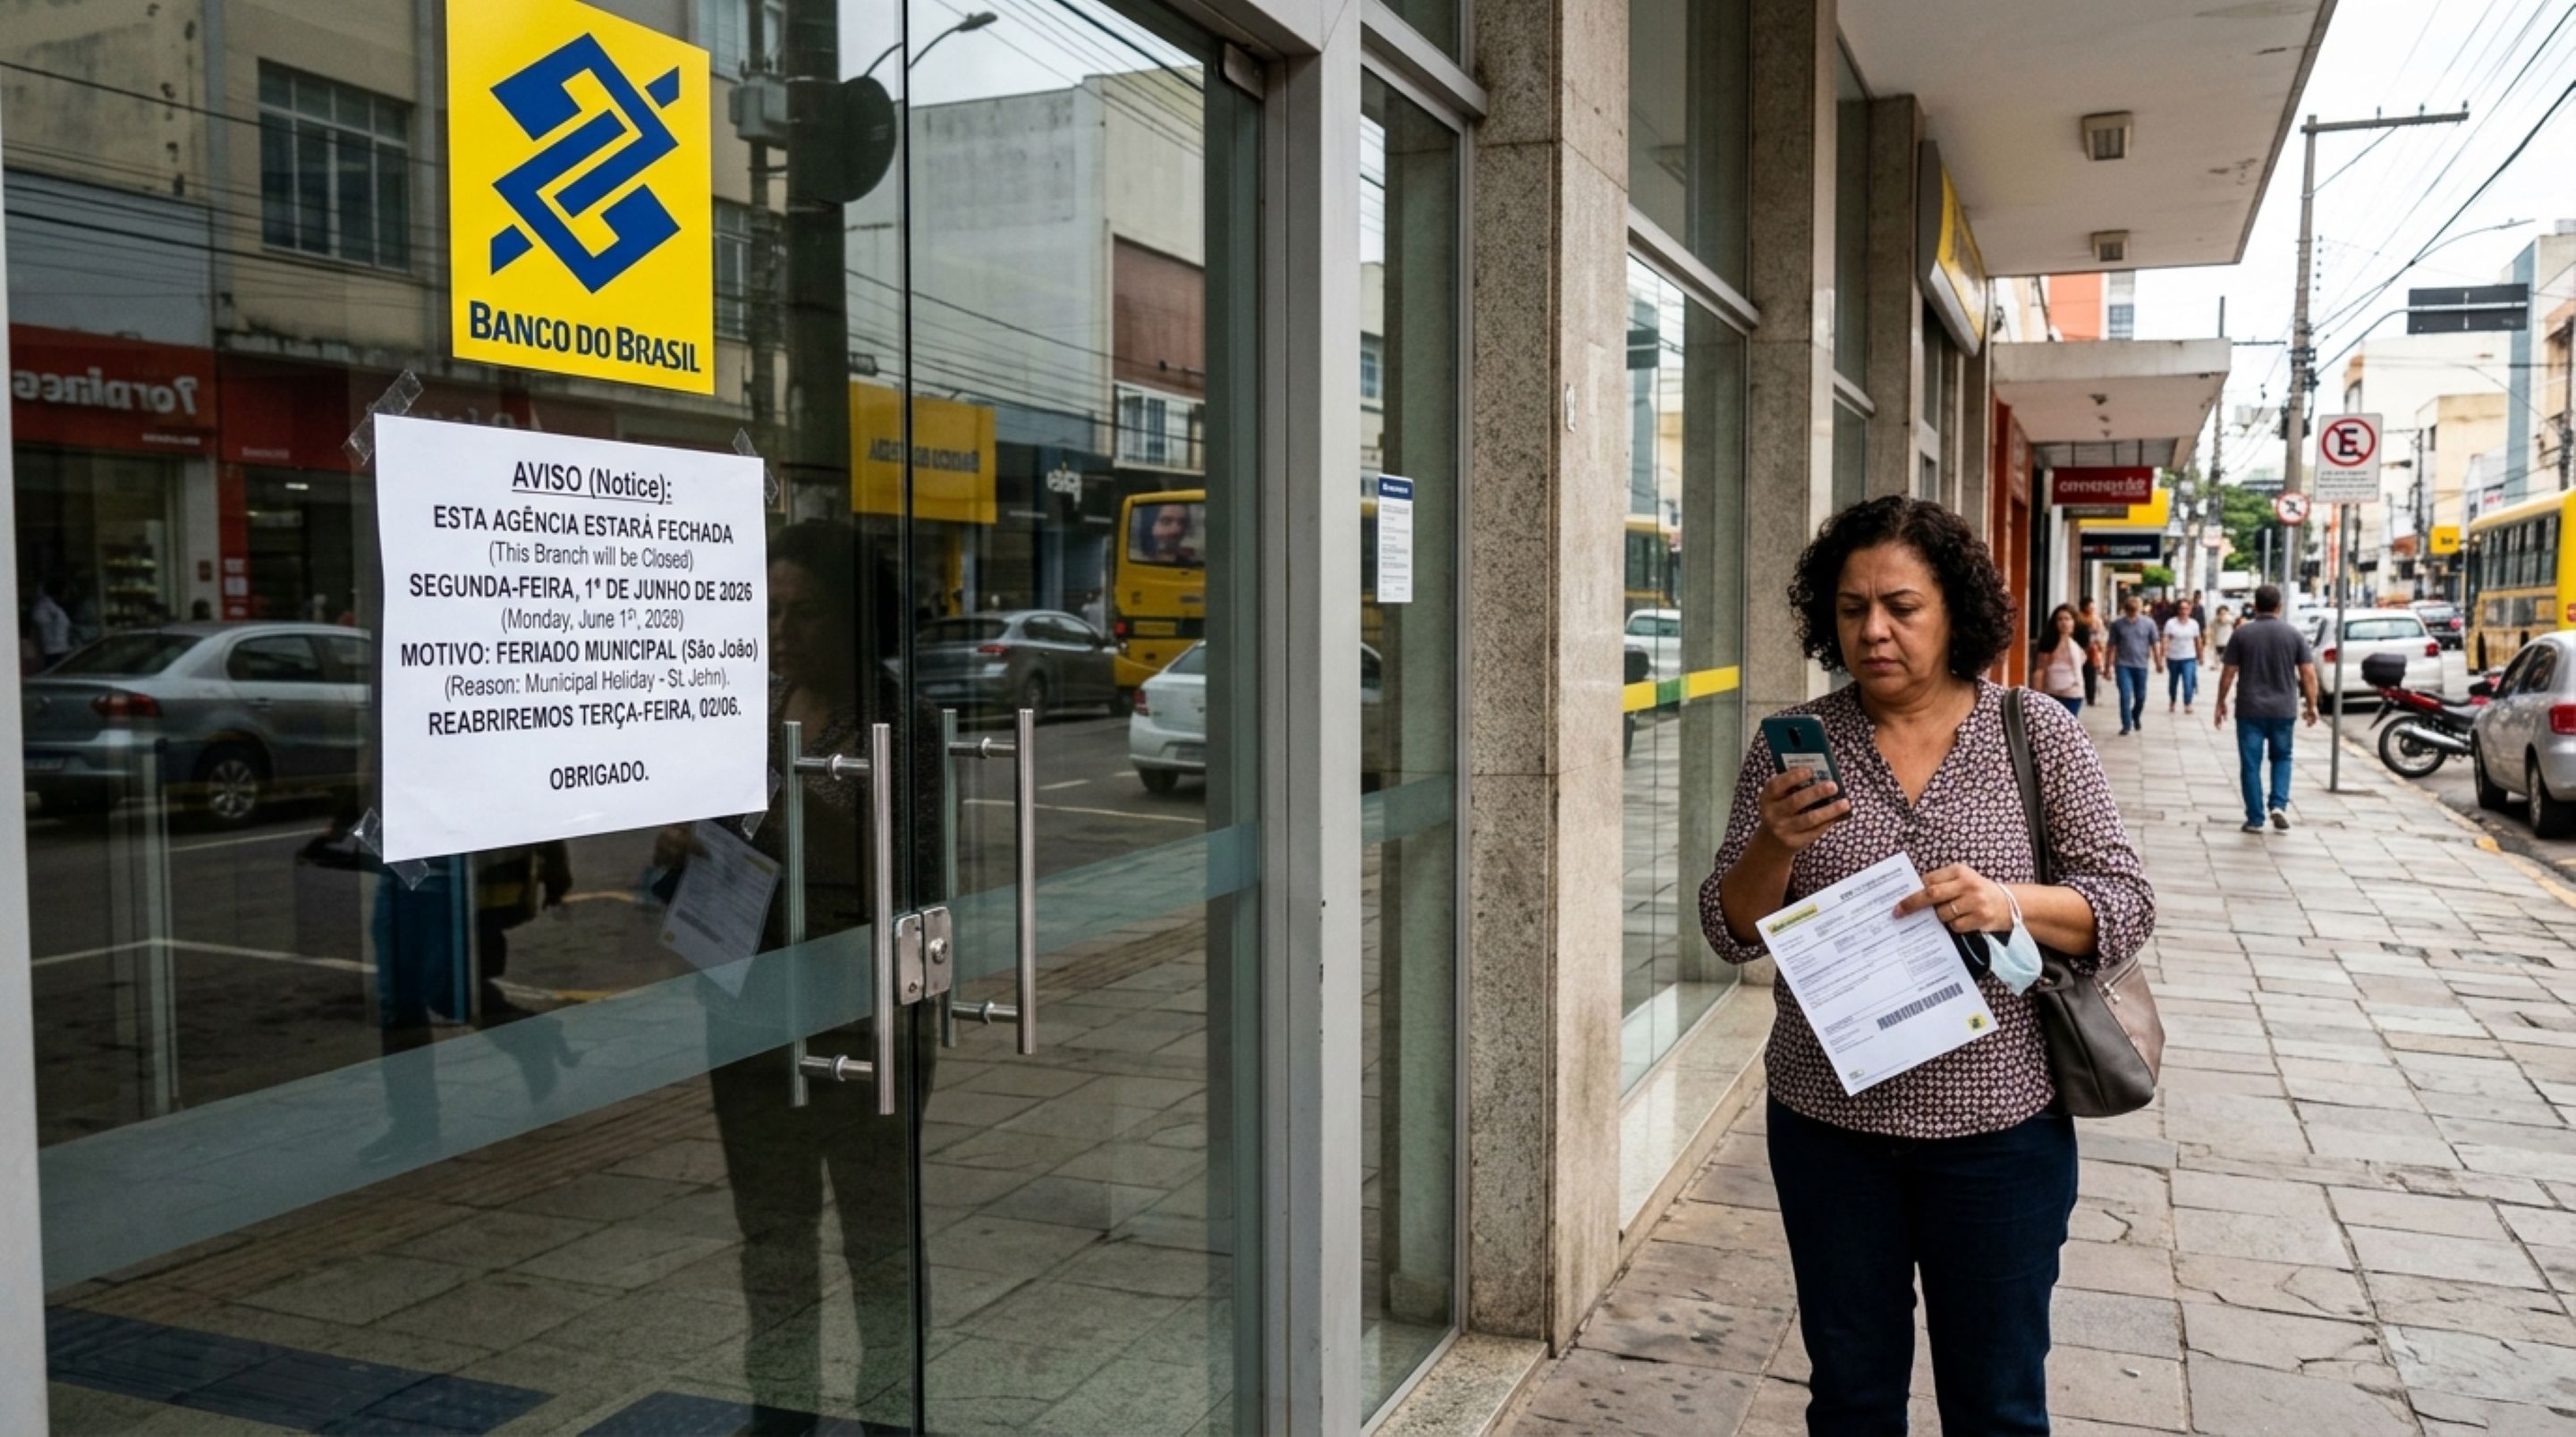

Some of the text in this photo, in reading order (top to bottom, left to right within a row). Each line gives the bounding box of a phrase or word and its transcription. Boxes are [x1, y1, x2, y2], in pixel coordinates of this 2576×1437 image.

[470, 300, 701, 374] BANCO DO BRASIL
[512, 461, 674, 503] AVISO (Notice):
[434, 503, 734, 545] ESTA AGÊNCIA ESTARÁ FECHADA
[488, 539, 695, 573] (This Branch will be Closed)
[409, 572, 580, 603] SEGUNDA-FEIRA,
[606, 577, 630, 600] DE
[632, 579, 691, 602] JUNHO
[694, 579, 716, 602] DE
[719, 581, 753, 602] 2026
[500, 607, 574, 635] (Monday,
[577, 608, 615, 630] June
[401, 642, 491, 668] MOTIVO:
[496, 639, 580, 665] FERIADO
[584, 638, 678, 664] MUNICIPAL
[681, 638, 716, 665] (São
[444, 673, 521, 703] (Reason:
[525, 671, 598, 696] Municipal
[428, 706, 574, 737] REABRIREMOS
[578, 698, 696, 730] TERÇA-FEIRA,
[549, 759, 650, 791] OBRIGADO.
